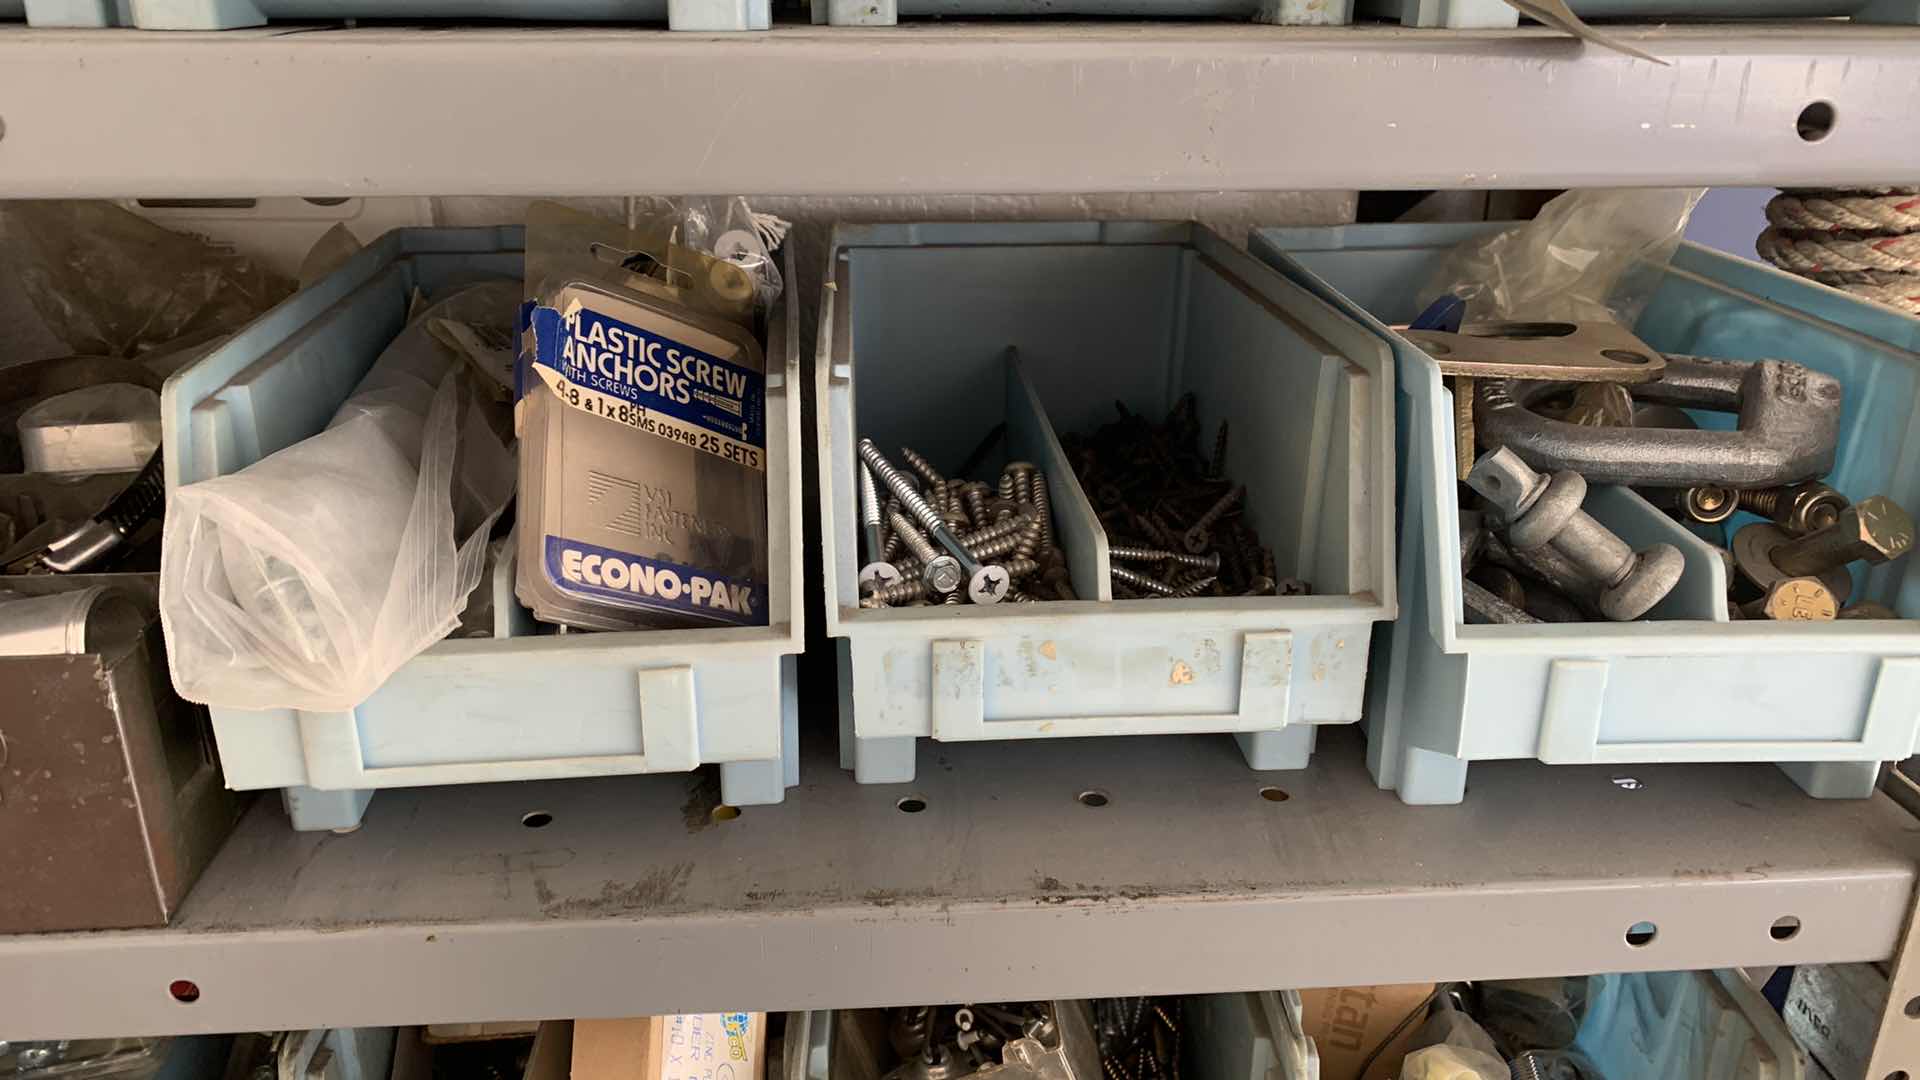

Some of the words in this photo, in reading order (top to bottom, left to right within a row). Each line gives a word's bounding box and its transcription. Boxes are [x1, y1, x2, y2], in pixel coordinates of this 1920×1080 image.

[563, 336, 690, 404] ANCHORS
[566, 312, 661, 367] PLASTIC
[667, 350, 747, 398] SCREW
[591, 374, 638, 400] SCREWS
[658, 423, 697, 446] 03948
[700, 433, 720, 453] 25
[724, 442, 759, 467] SETS
